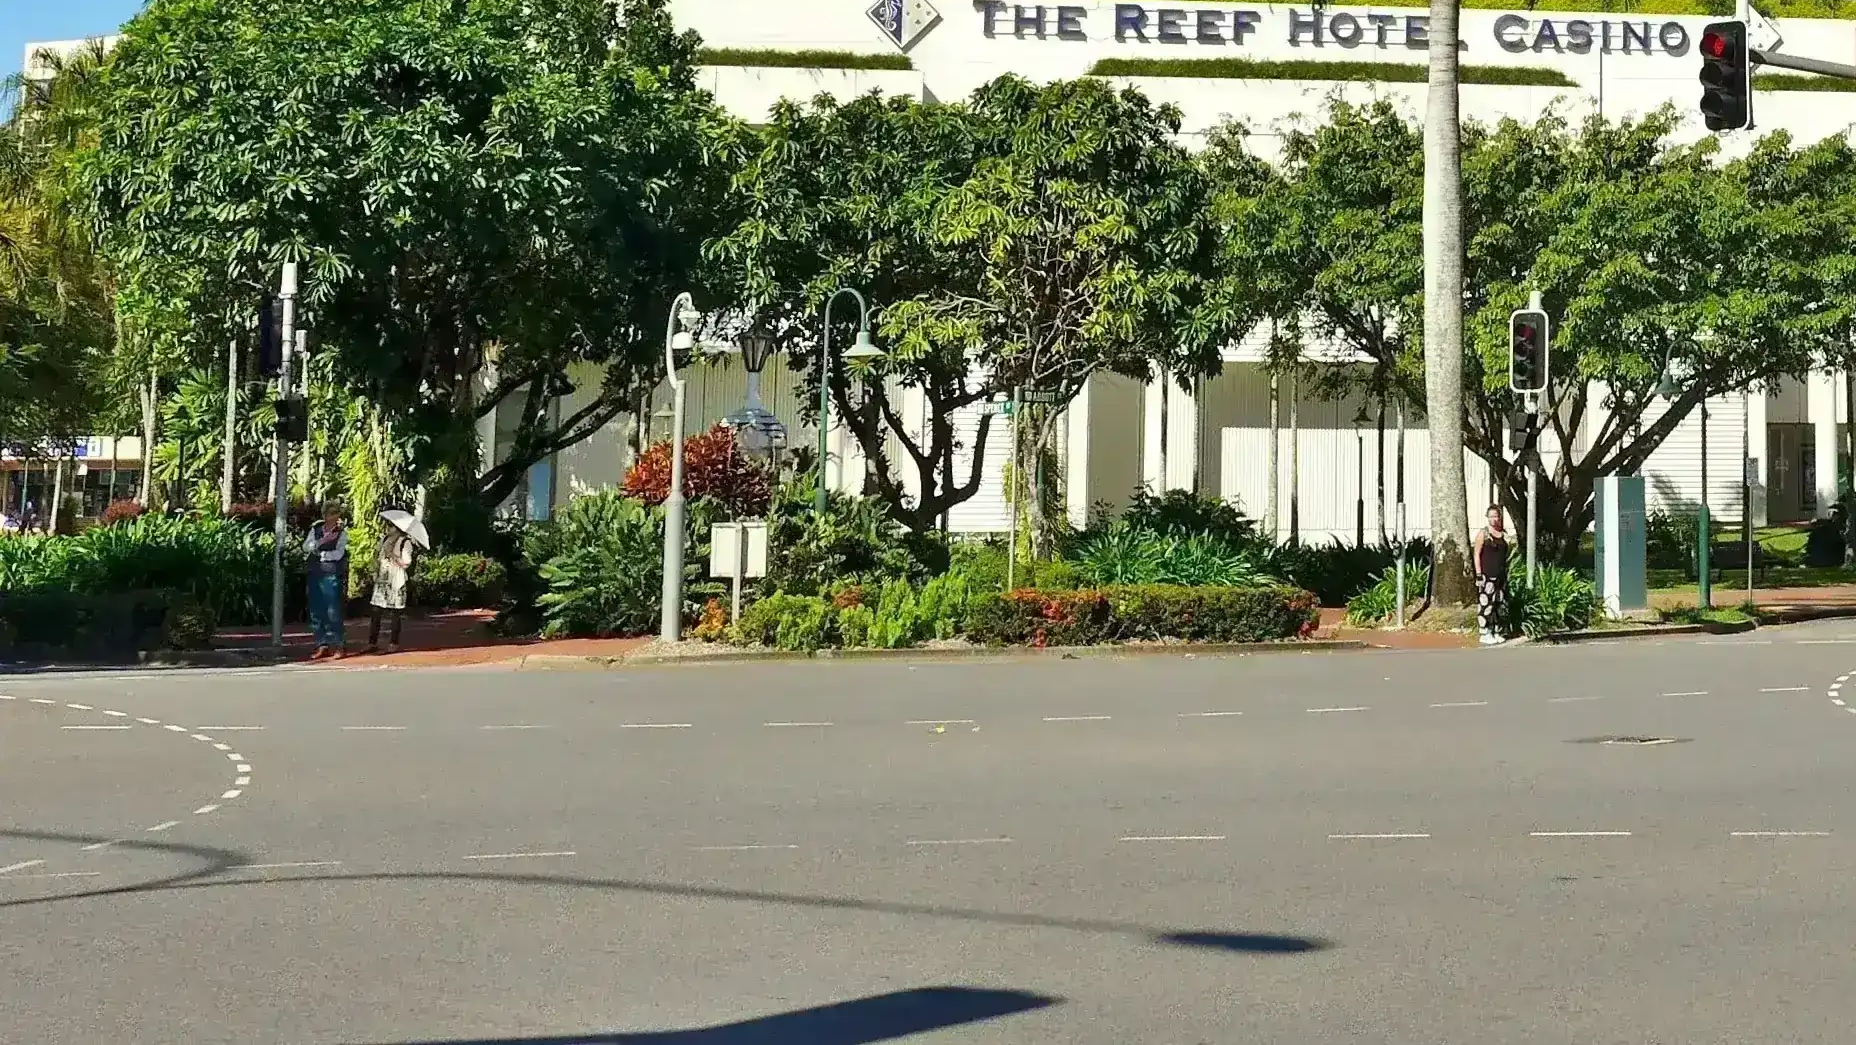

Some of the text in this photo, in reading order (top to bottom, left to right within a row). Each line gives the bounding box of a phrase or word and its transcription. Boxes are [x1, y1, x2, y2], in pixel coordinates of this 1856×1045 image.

[973, 0, 1690, 57] THE REEF HOTE CASINO
